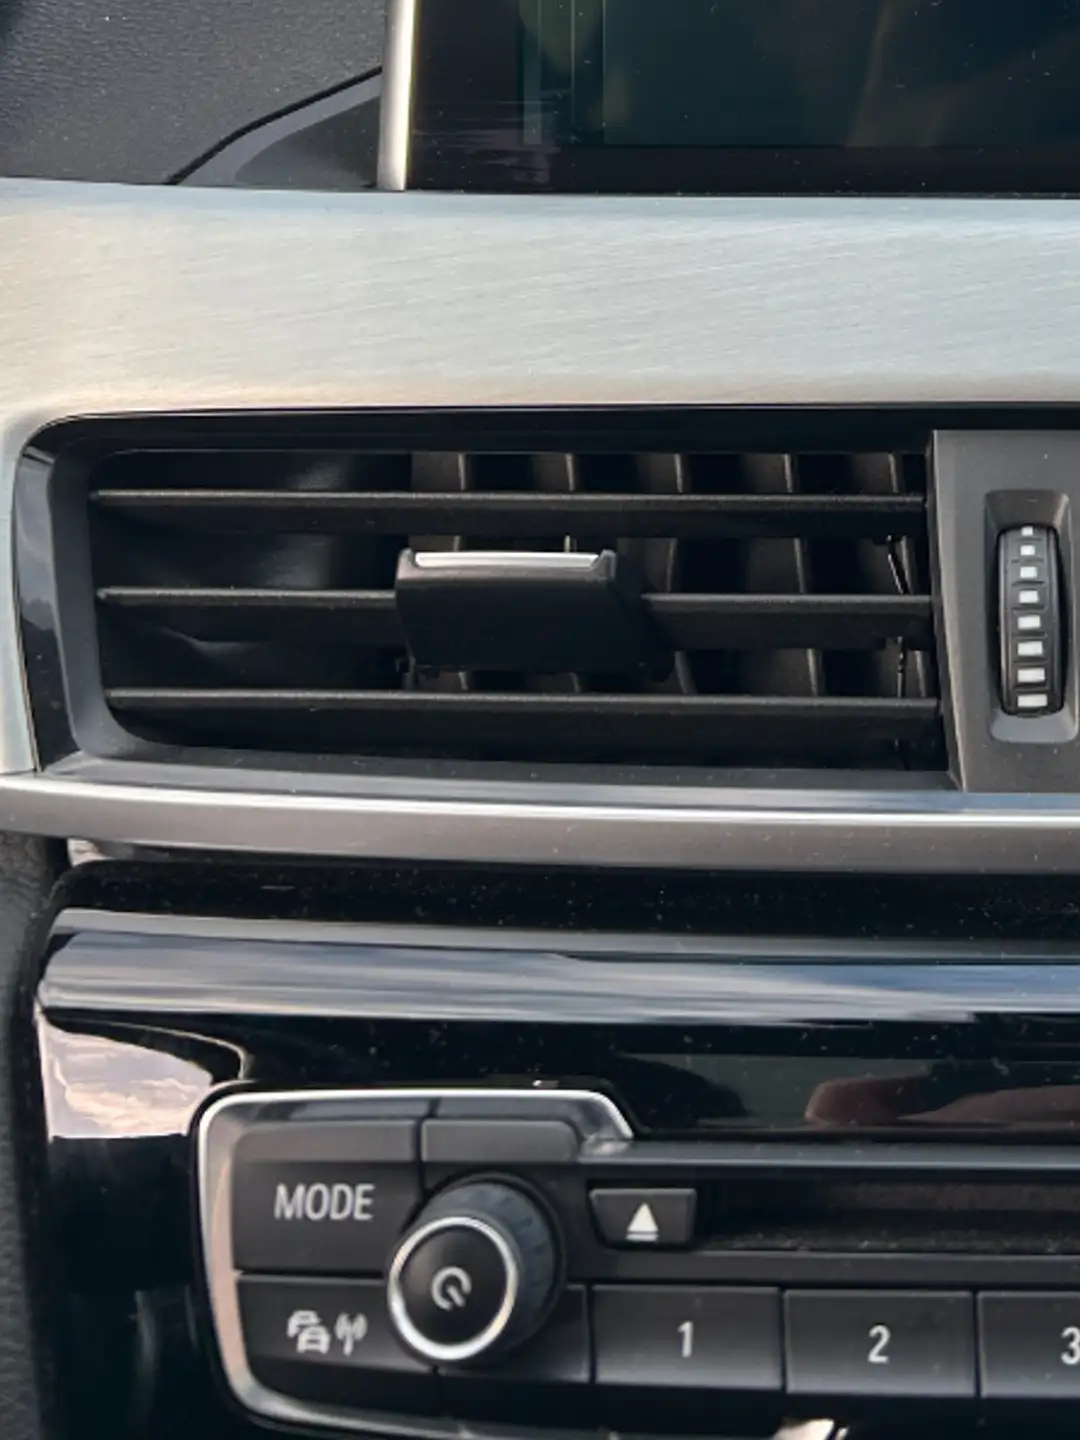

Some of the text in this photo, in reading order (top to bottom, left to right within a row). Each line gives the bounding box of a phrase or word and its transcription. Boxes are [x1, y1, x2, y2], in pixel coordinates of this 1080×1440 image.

[273, 1183, 374, 1222] MODE
[677, 1321, 694, 1358] 1
[867, 1325, 891, 1364] 2
